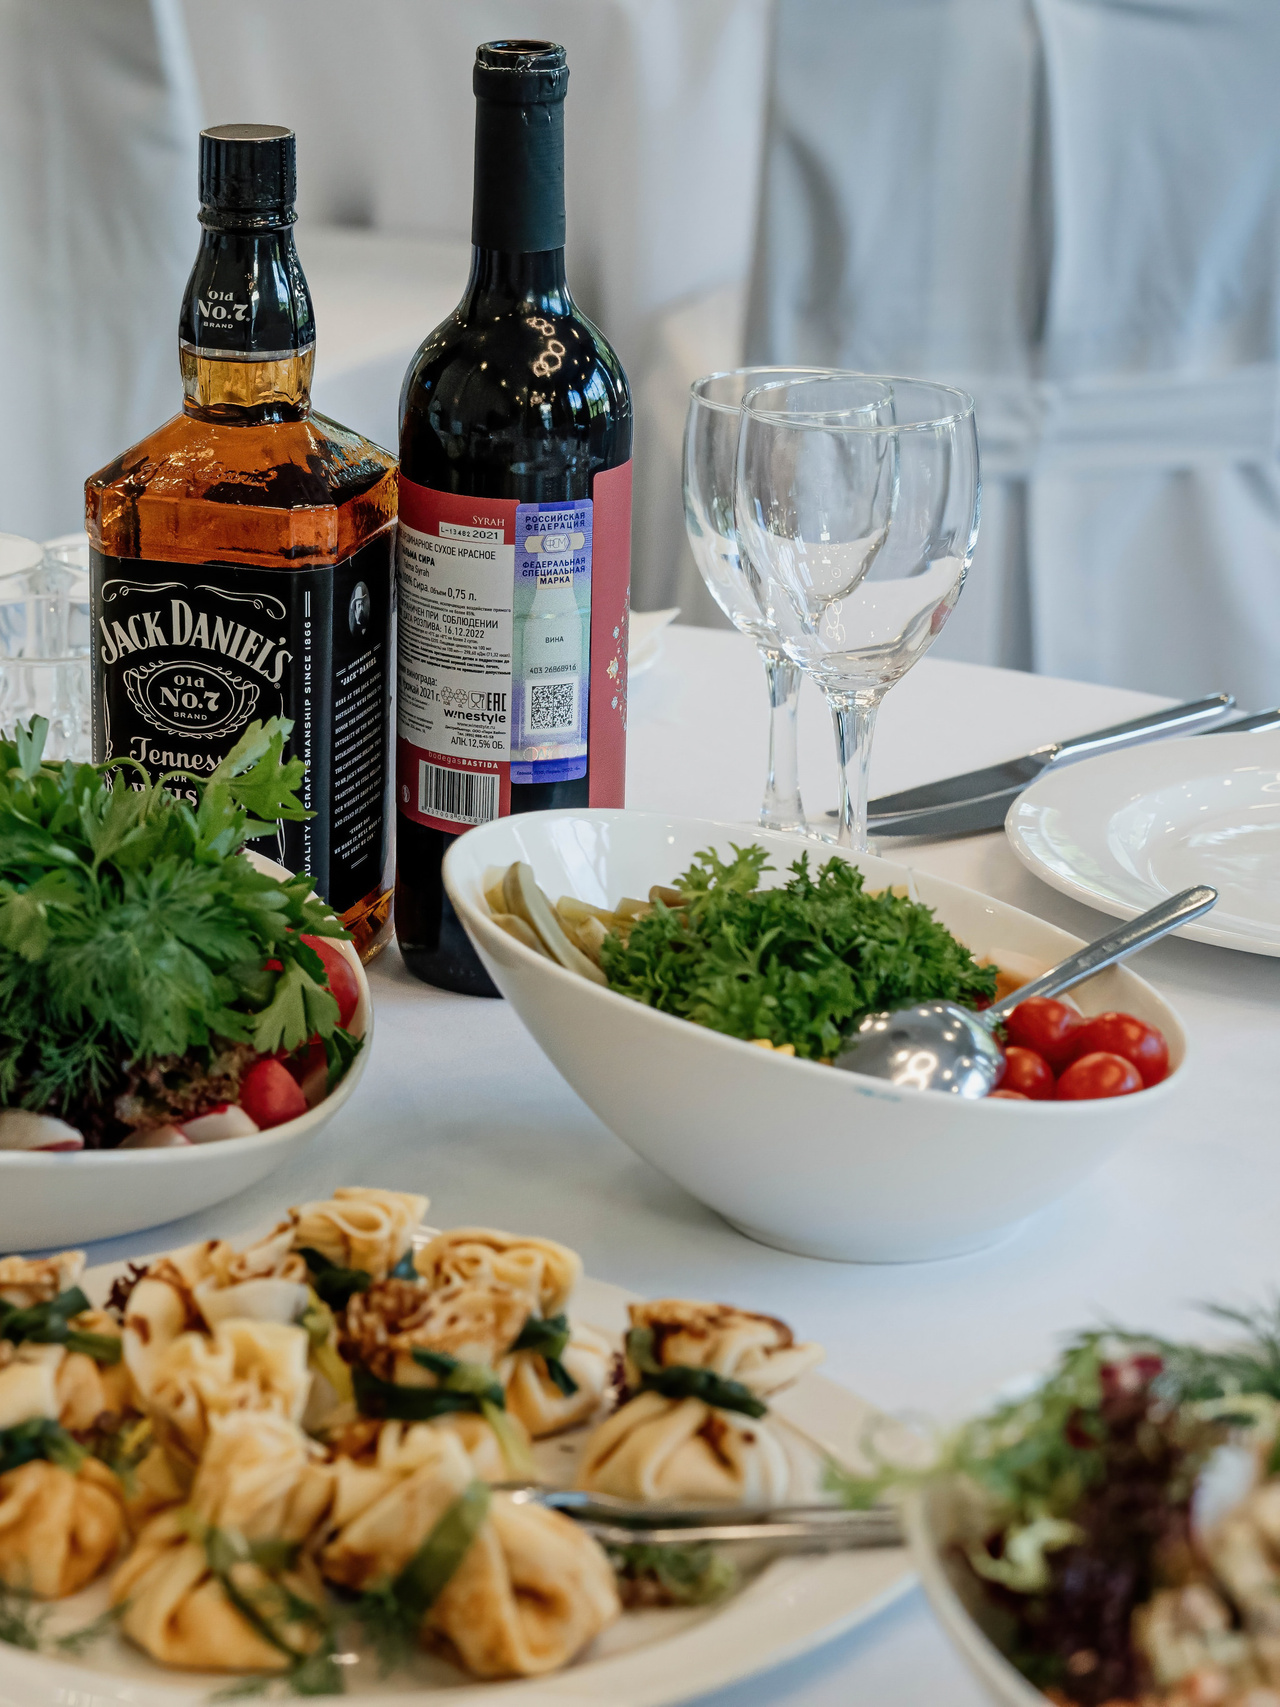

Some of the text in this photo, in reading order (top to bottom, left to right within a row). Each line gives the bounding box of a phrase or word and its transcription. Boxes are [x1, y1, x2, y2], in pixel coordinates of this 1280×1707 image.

[208, 290, 234, 301] Old
[196, 299, 249, 321] No.7
[203, 321, 234, 329] BRAND
[472, 515, 505, 527] SYRAH
[525, 511, 586, 523] РОССИЙСКАЯ
[525, 519, 586, 532] ФЕДЕРАЦИЯ
[472, 529, 499, 540] 2021
[434, 543, 457, 556] СУХОЕ
[458, 547, 496, 560] КРАСНОЕ
[418, 554, 436, 567] СИРА
[522, 557, 586, 569] ФЕДЕРАЛЬНАЯ
[414, 564, 430, 578] Syrah
[522, 565, 586, 578] СПЕЦИАЛЬНАЯ
[540, 576, 570, 585] МАРКА
[447, 587, 467, 600] 0,75
[468, 592, 478, 602] л.
[425, 609, 439, 621] ПРИ
[442, 613, 499, 629] СОБЛЮДЕНИИ
[304, 621, 312, 650] 1866
[444, 624, 485, 639] 16.12.2022
[99, 600, 294, 683] JACK DANIEL'S
[545, 636, 564, 644] ВИНА
[304, 655, 312, 694] SINCE
[530, 664, 577, 674] 403 26868916
[173, 674, 205, 688] Old
[406, 668, 438, 687] винограда:
[159, 686, 220, 712] No.7
[419, 686, 434, 701] 2021
[486, 692, 507, 712] EAC
[173, 711, 208, 721] BRAND
[468, 738, 491, 749] 12,5%
[491, 740, 505, 750] ОБ.
[304, 699, 312, 809] CRAFTSMANSHIP
